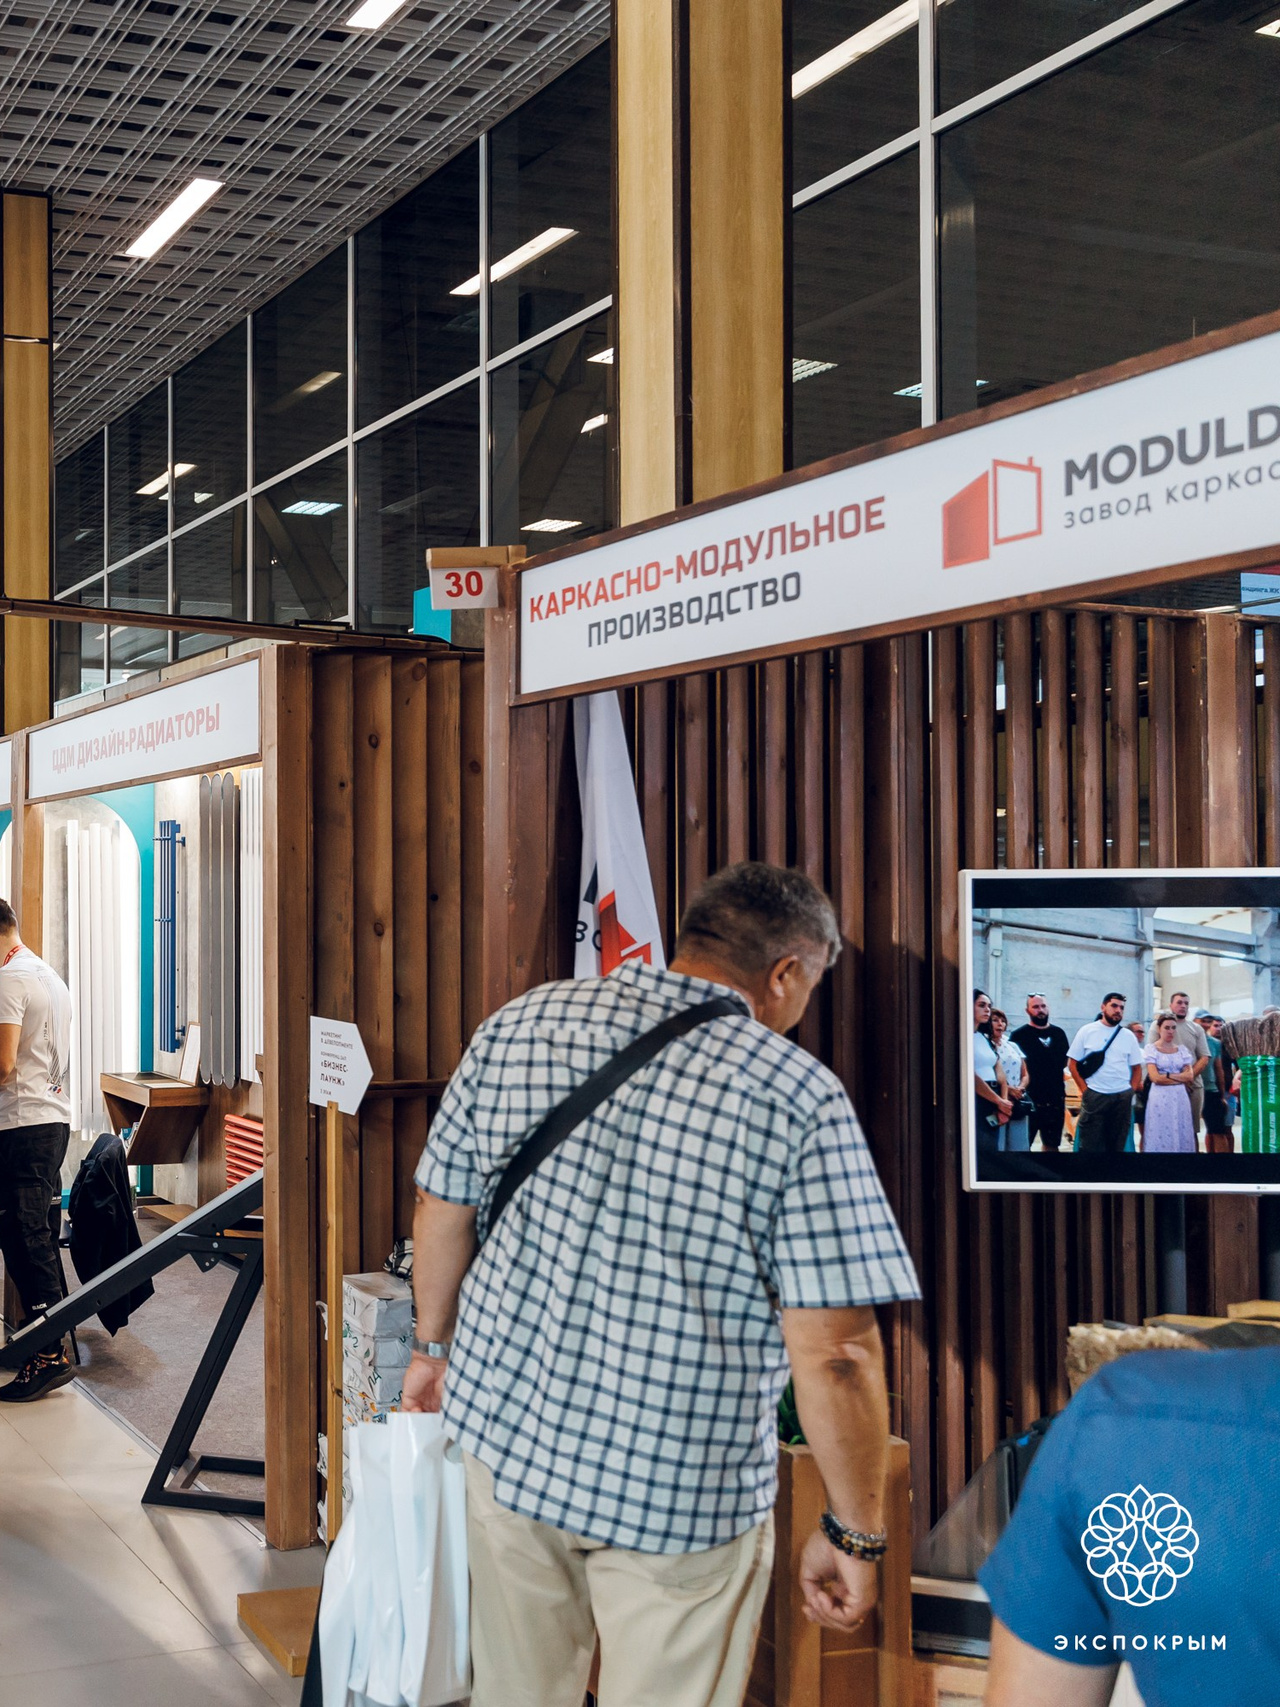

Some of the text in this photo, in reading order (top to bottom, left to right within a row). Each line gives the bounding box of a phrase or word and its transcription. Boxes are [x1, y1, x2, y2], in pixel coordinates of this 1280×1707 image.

[1064, 405, 1280, 497] MODULD
[1064, 492, 1152, 530] завод
[444, 570, 483, 598] 30
[529, 496, 886, 623] КАРКАСНО-МОДУЛЬНОЕ
[587, 571, 802, 648] ПРОИЗВОДСТВО
[52, 703, 220, 774] ЦДМ ДИЗАЙН-РАДИАТОРЫ
